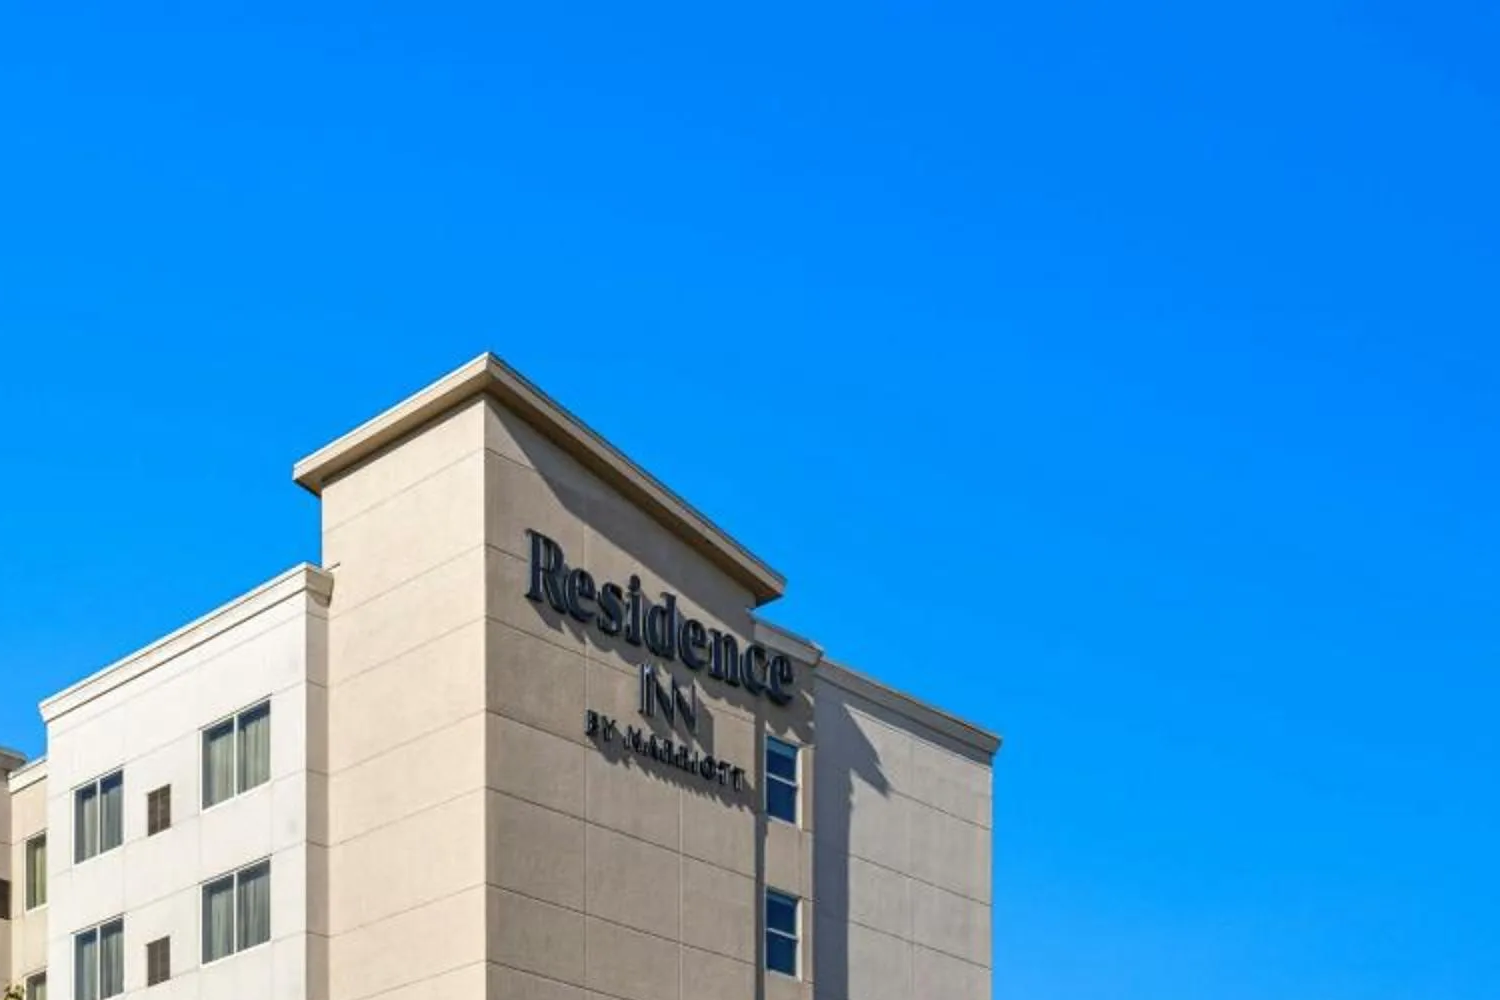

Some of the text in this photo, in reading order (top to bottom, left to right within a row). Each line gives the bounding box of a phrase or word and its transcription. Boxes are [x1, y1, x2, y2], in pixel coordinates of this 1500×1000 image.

[525, 528, 793, 705] Residence
[586, 709, 615, 741] BY
[638, 664, 699, 734] INN
